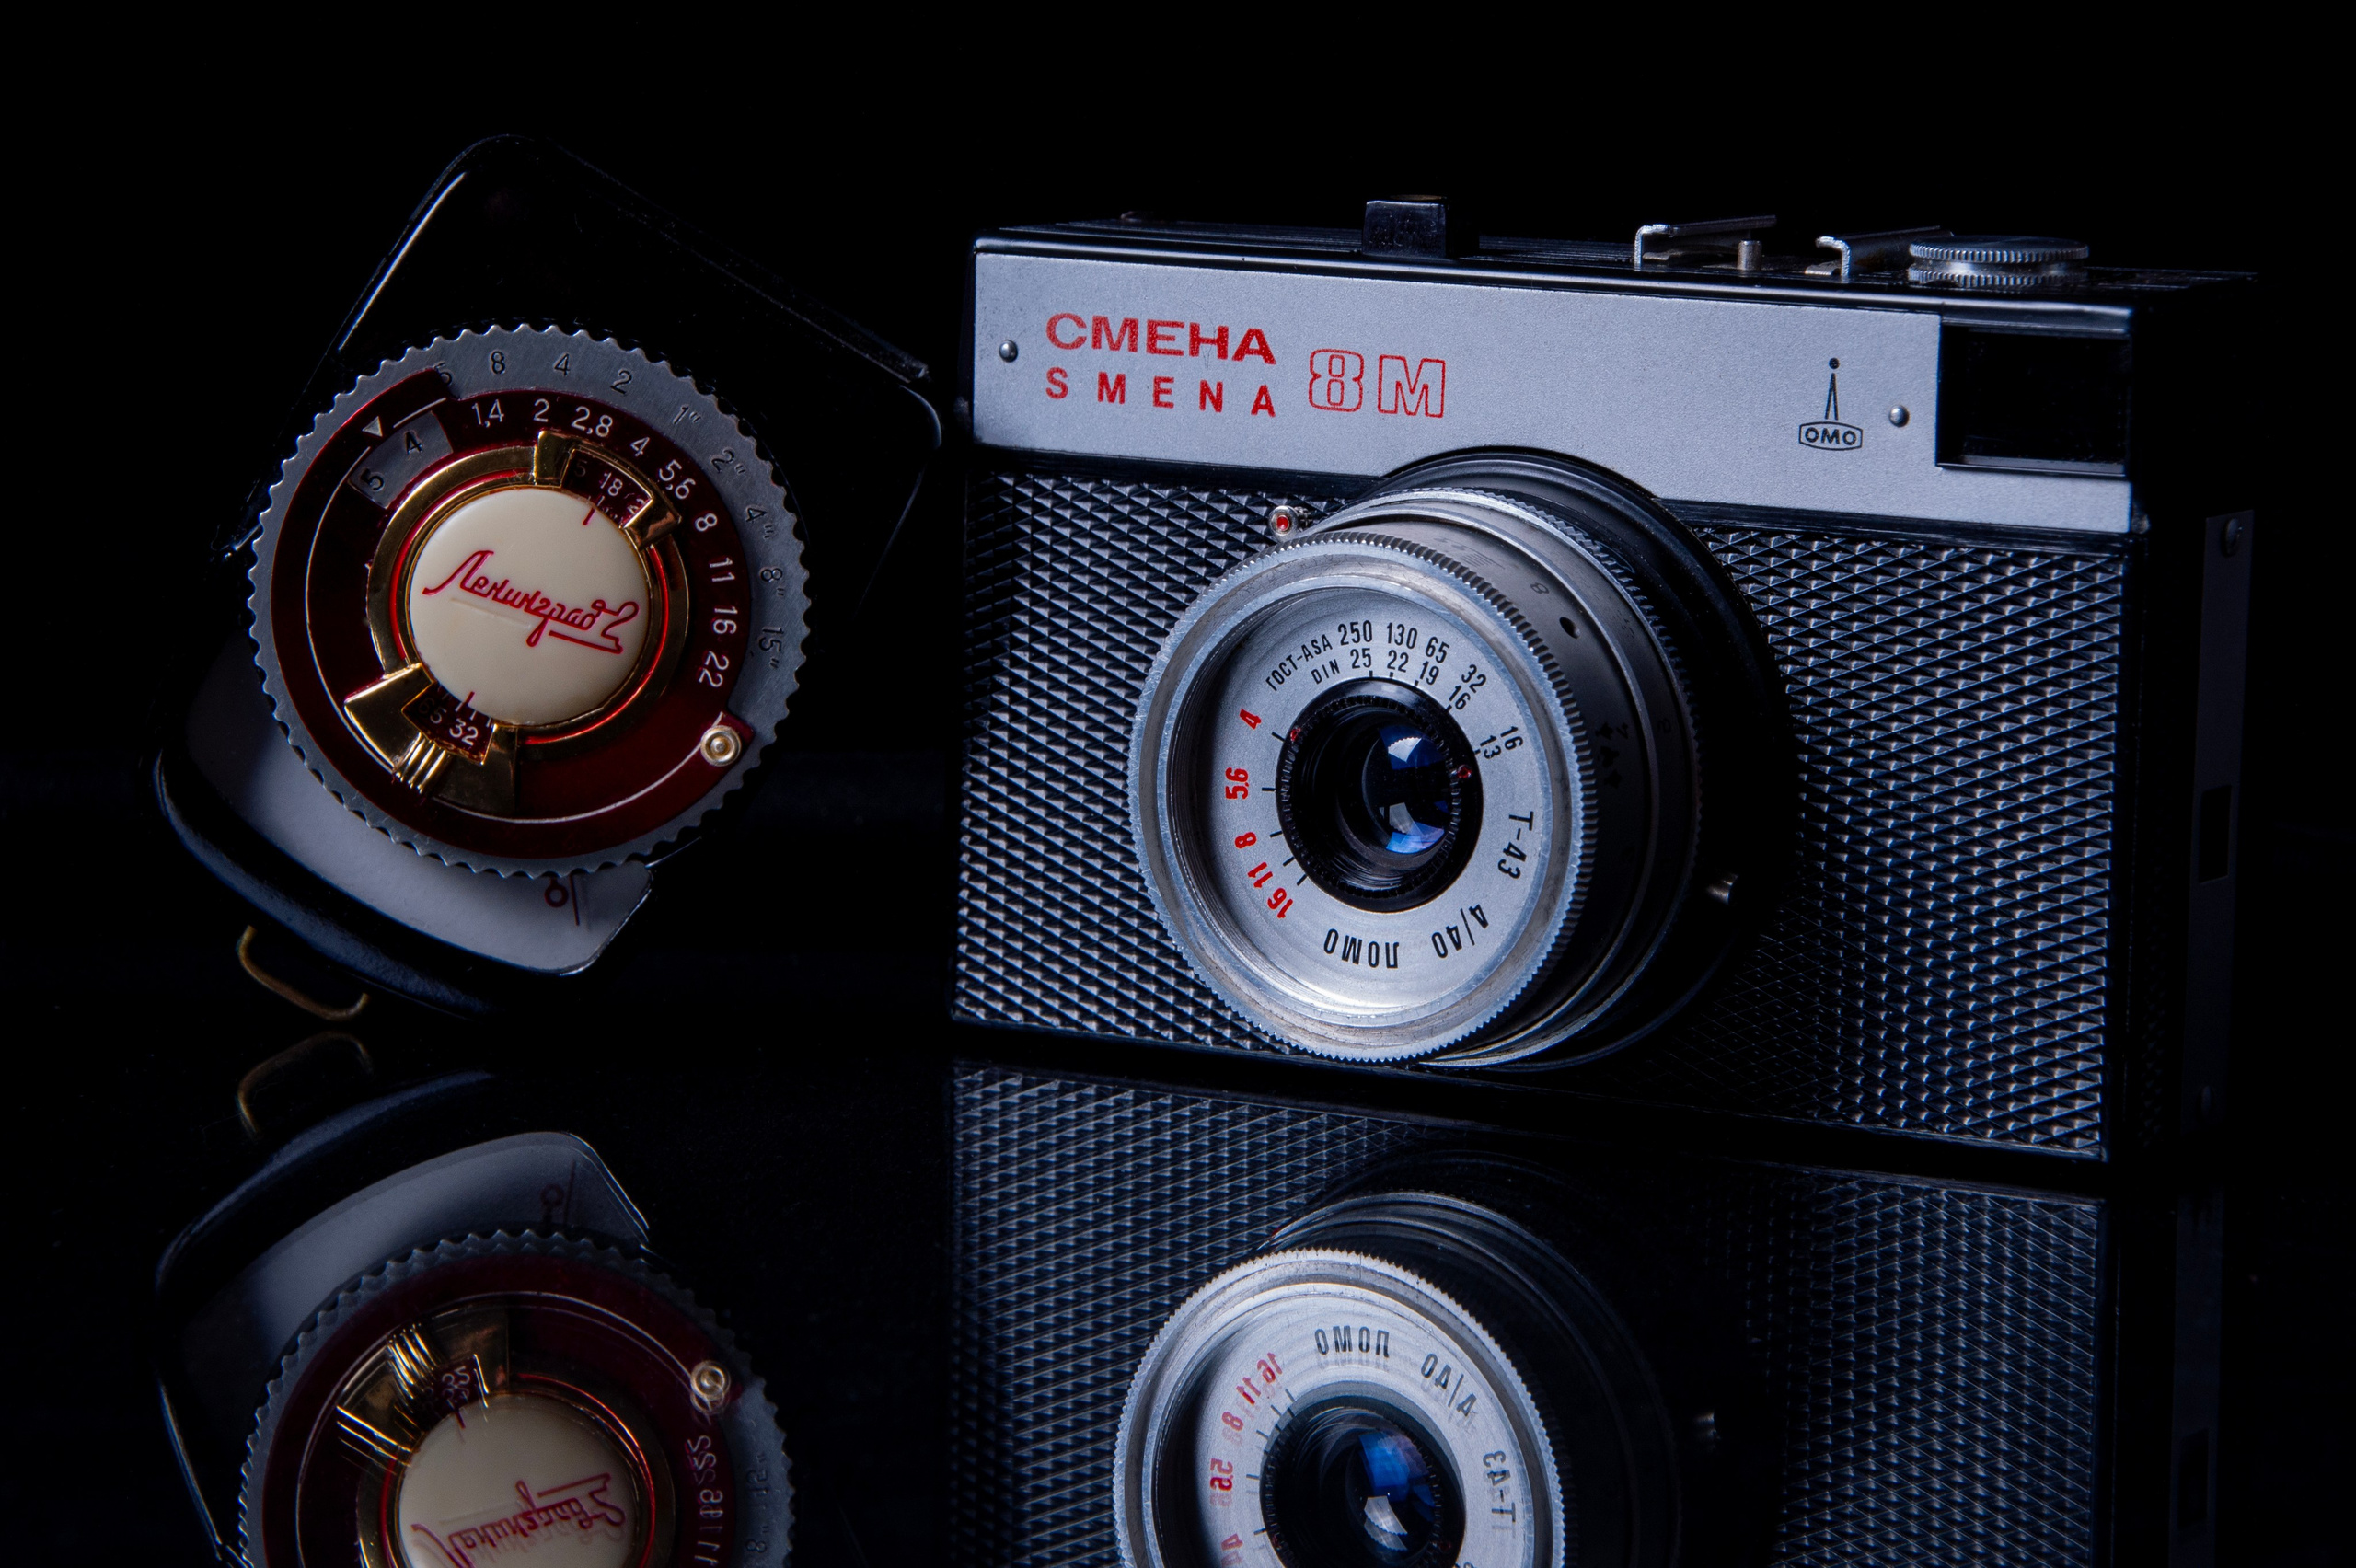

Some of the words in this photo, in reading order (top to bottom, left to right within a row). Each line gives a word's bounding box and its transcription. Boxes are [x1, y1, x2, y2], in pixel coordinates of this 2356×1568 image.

[1045, 312, 1276, 365] СМЕНА
[490, 351, 506, 375] 8
[553, 353, 571, 376] 4
[610, 370, 632, 395] 2
[1045, 367, 1276, 418] SMENA
[533, 398, 550, 423] 2
[571, 405, 614, 439] 2,8
[360, 468, 385, 491] 5
[405, 432, 422, 455] 4
[629, 436, 651, 458] 4
[600, 471, 624, 497] 18
[657, 459, 697, 501] 5,6
[693, 513, 718, 533] 8
[709, 557, 736, 583] 11
[713, 605, 739, 635] 16
[698, 650, 731, 688] 22
[1337, 619, 1373, 646] 250
[1386, 622, 1418, 650] 130
[1425, 636, 1450, 663] 65
[1461, 663, 1486, 694] 32
[1500, 725, 1524, 751] 16
[1240, 709, 1262, 730] 4
[1311, 659, 1341, 685] DIN
[1350, 648, 1372, 669] 25
[1387, 650, 1409, 673] 22
[1419, 661, 1440, 686] 19
[1449, 685, 1471, 710] 16
[1480, 734, 1502, 759] 13
[448, 718, 479, 747] 32
[1234, 832, 1257, 849] 8
[1247, 862, 1273, 889] 11
[1267, 887, 1294, 919] 16
[1431, 904, 1489, 959] 4/40
[1323, 928, 1400, 969] ЛОМО
